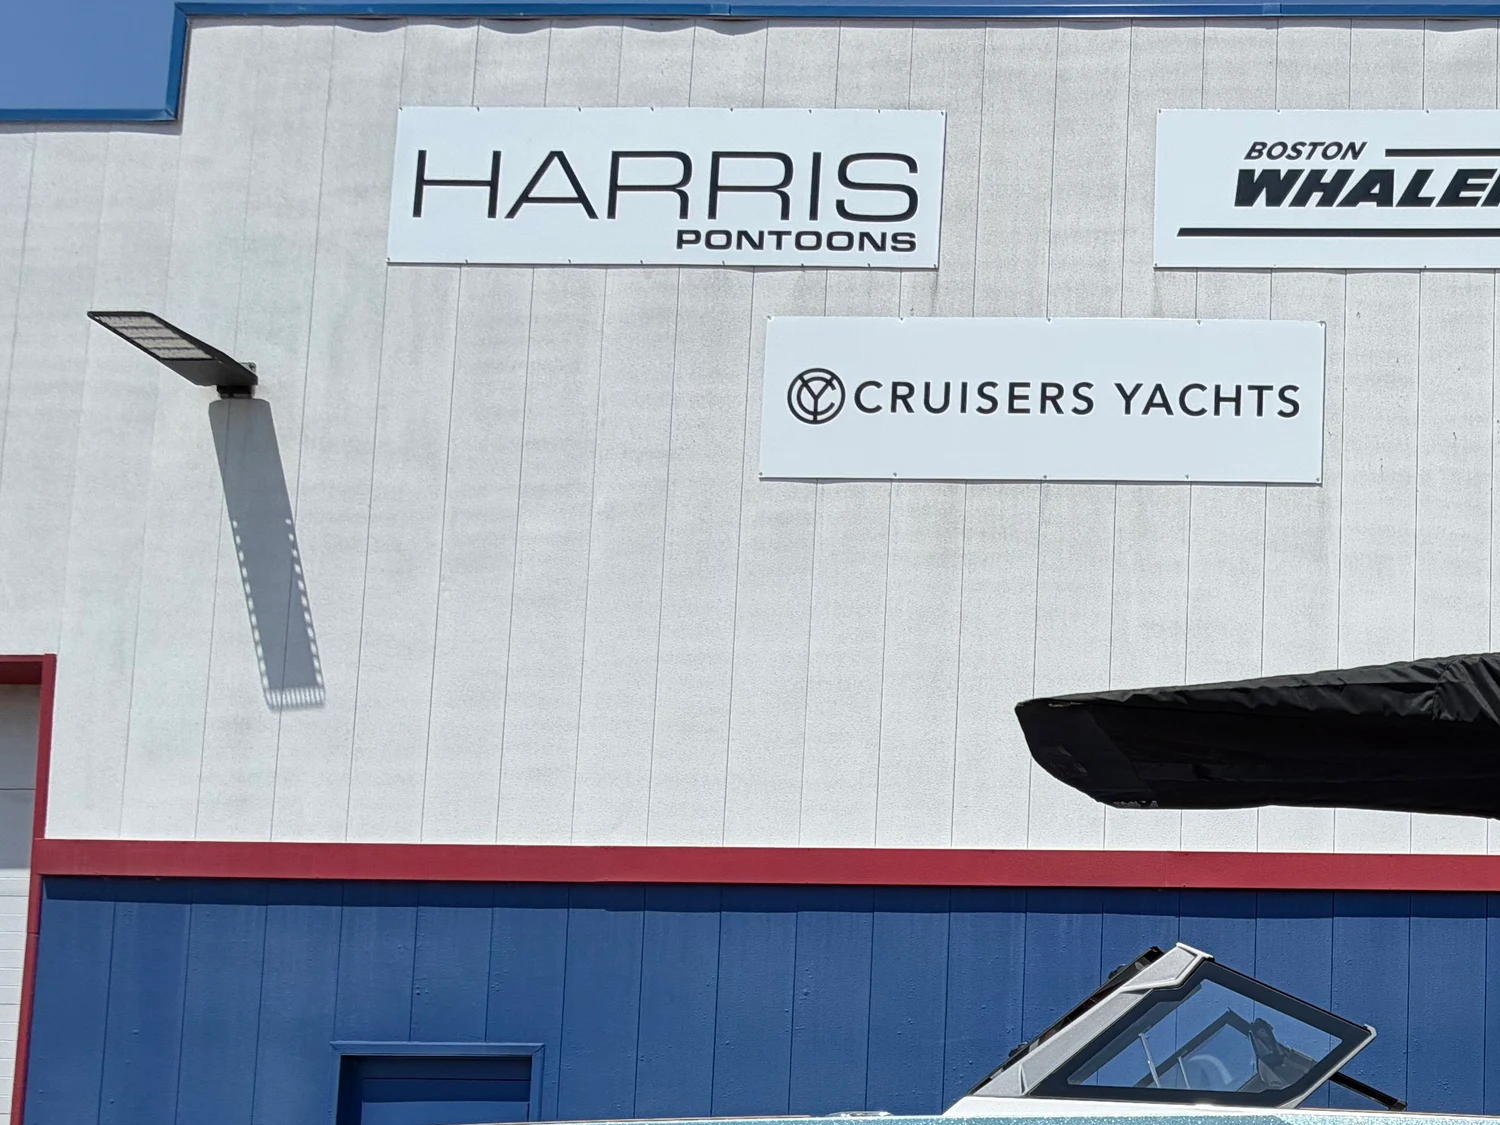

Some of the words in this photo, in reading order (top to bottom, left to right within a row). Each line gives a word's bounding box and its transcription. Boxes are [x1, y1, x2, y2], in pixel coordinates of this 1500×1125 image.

[1243, 141, 1368, 161] BOSTON
[413, 149, 919, 223] HARRIS
[676, 229, 917, 253] PONTOONS
[854, 380, 1094, 415] CRUISERS
[1114, 382, 1300, 418] YACHTS
